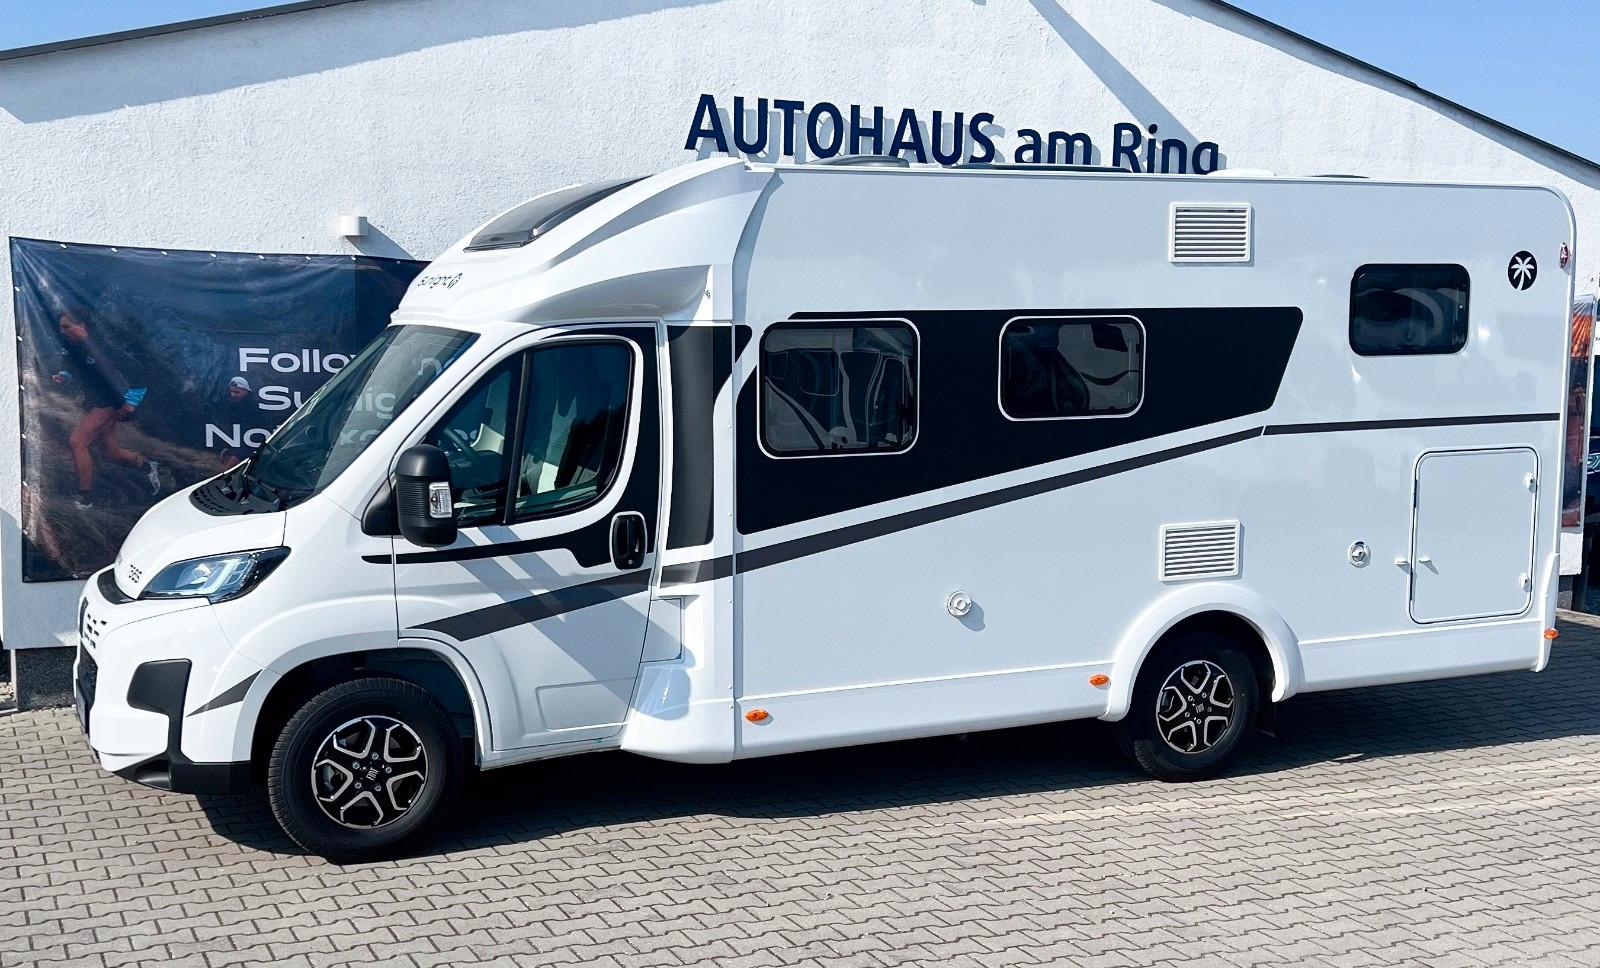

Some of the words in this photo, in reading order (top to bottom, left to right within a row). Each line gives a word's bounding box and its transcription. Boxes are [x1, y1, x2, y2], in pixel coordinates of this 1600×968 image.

[684, 94, 995, 165] AUTOHAUS
[1014, 128, 1092, 165] am
[238, 347, 357, 373] Follo
[205, 423, 279, 448] No
